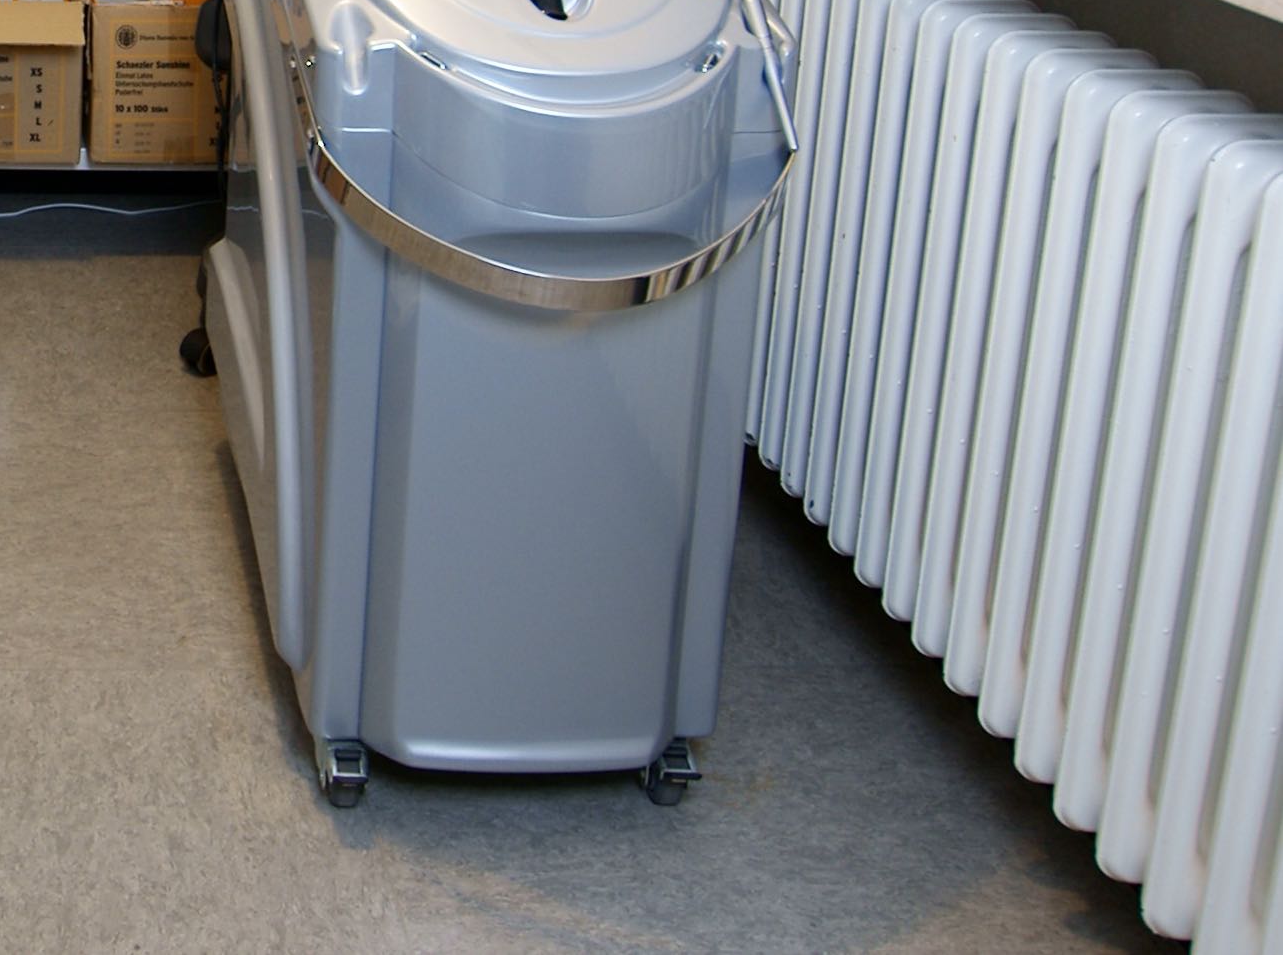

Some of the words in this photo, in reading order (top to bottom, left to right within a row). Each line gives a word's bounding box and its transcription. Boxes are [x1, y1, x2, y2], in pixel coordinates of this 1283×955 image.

[30, 67, 43, 78] XS
[36, 84, 43, 94] S
[34, 101, 42, 110] M
[115, 104, 124, 113] 10
[134, 104, 149, 113] 100
[35, 117, 42, 126] L
[29, 133, 41, 143] XL
